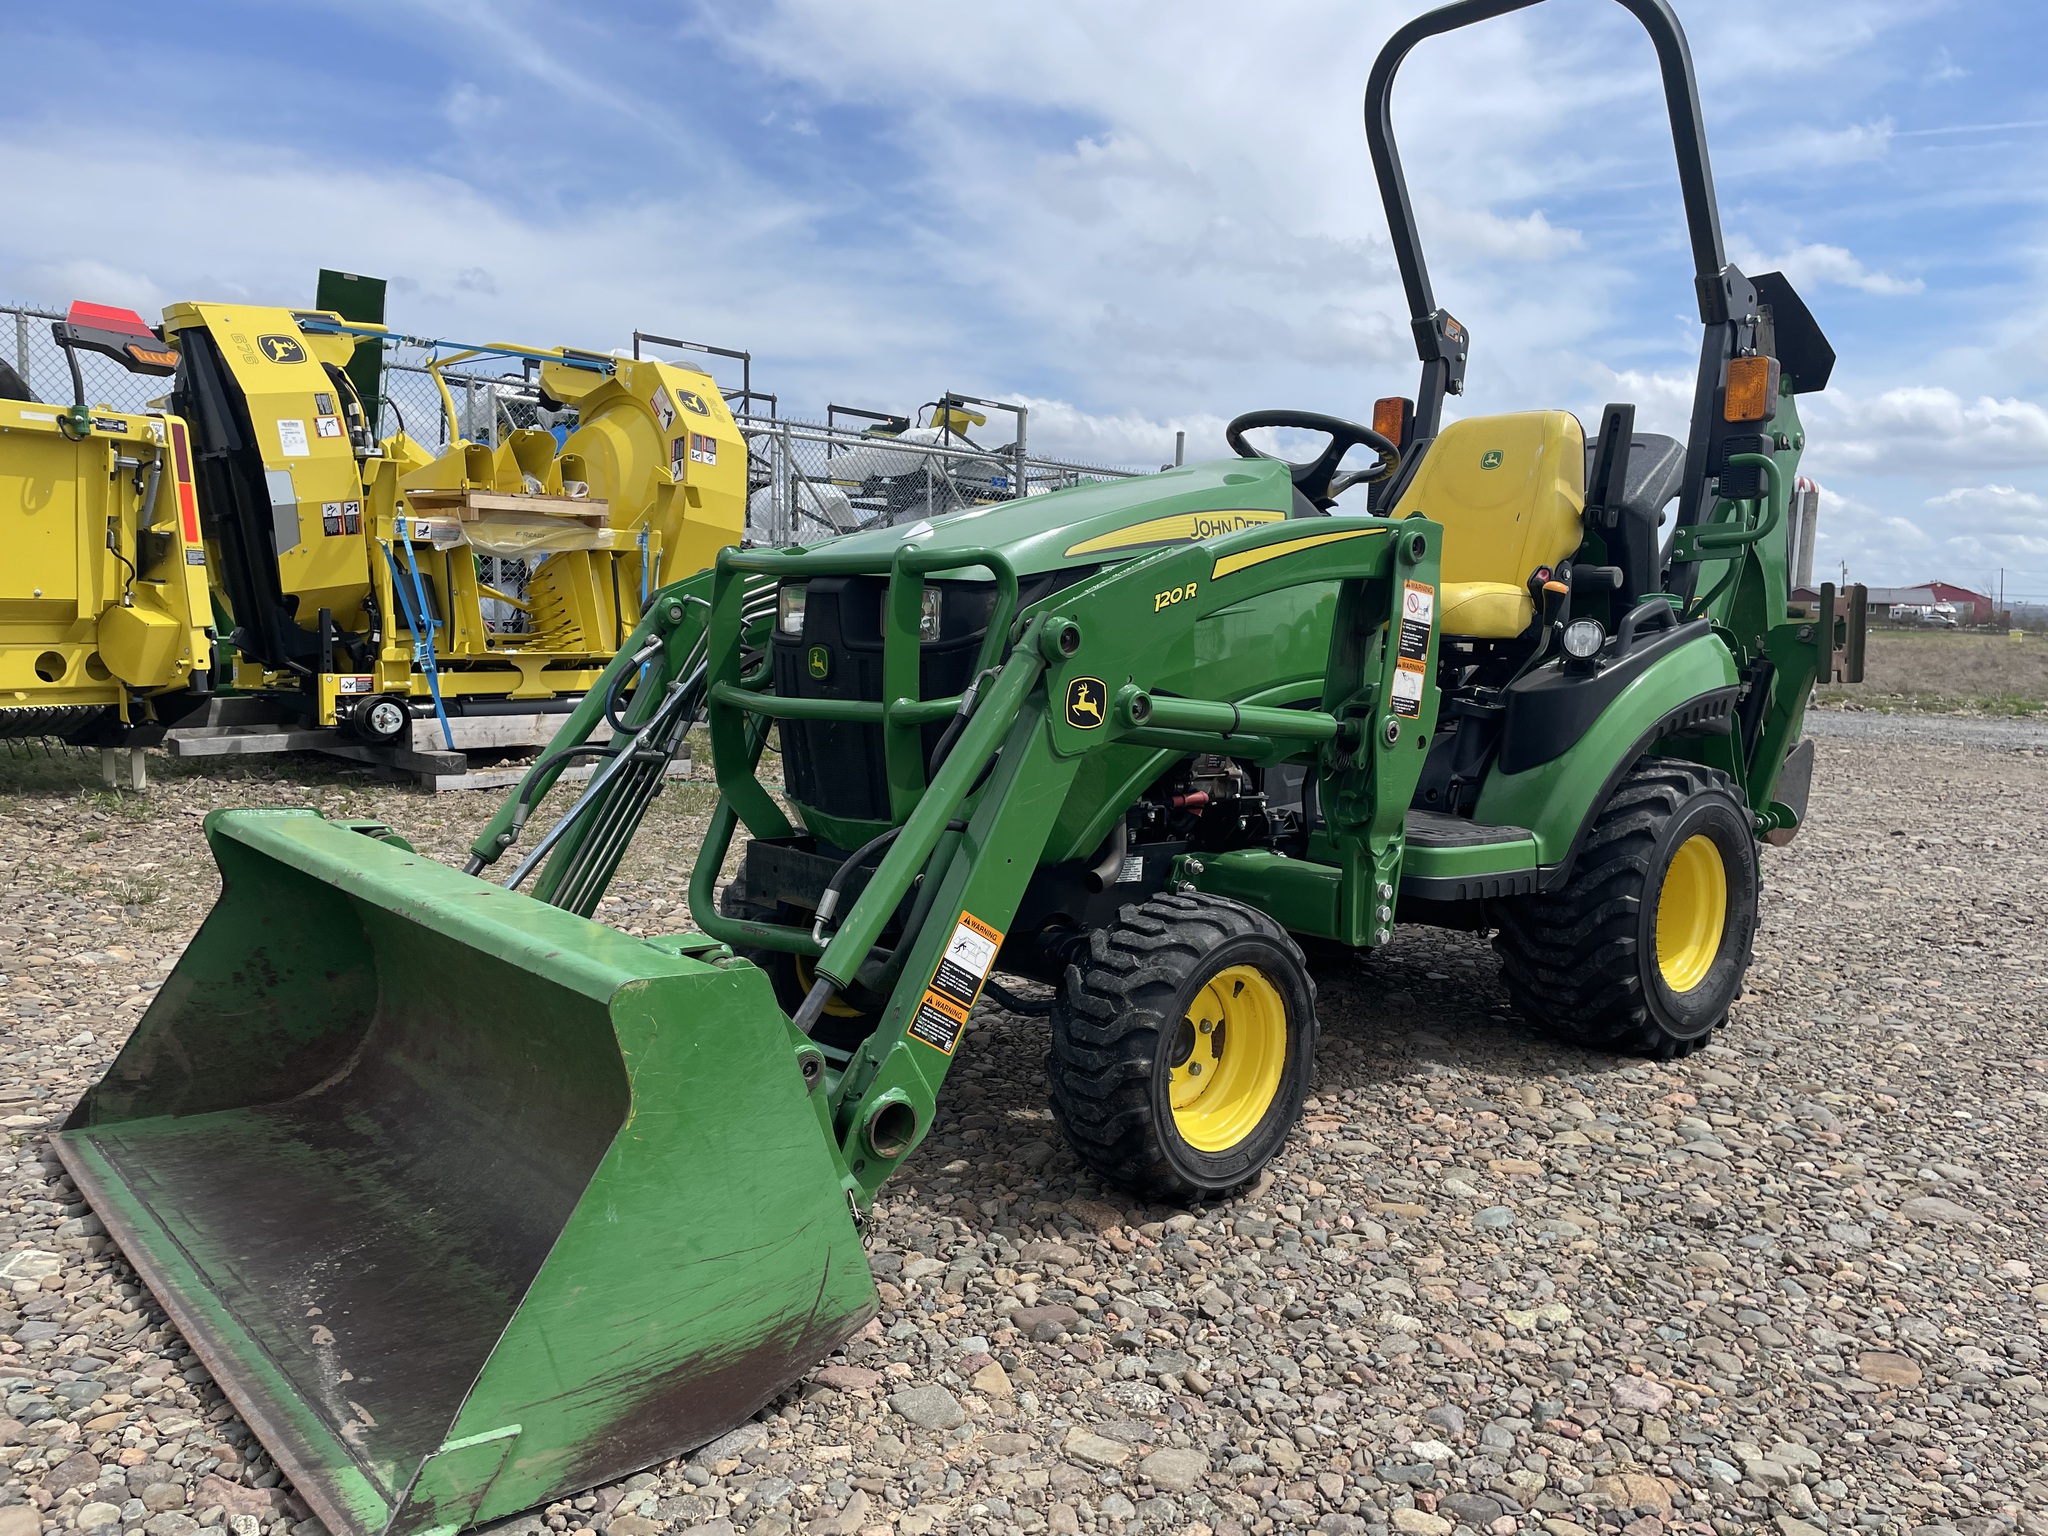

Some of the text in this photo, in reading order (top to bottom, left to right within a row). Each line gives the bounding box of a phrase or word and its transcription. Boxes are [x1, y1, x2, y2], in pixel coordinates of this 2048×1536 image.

[1190, 516, 1233, 537] JOHN
[1401, 661, 1424, 673] WARNING
[970, 919, 998, 941] WARNING
[934, 998, 963, 1020] WARNING
